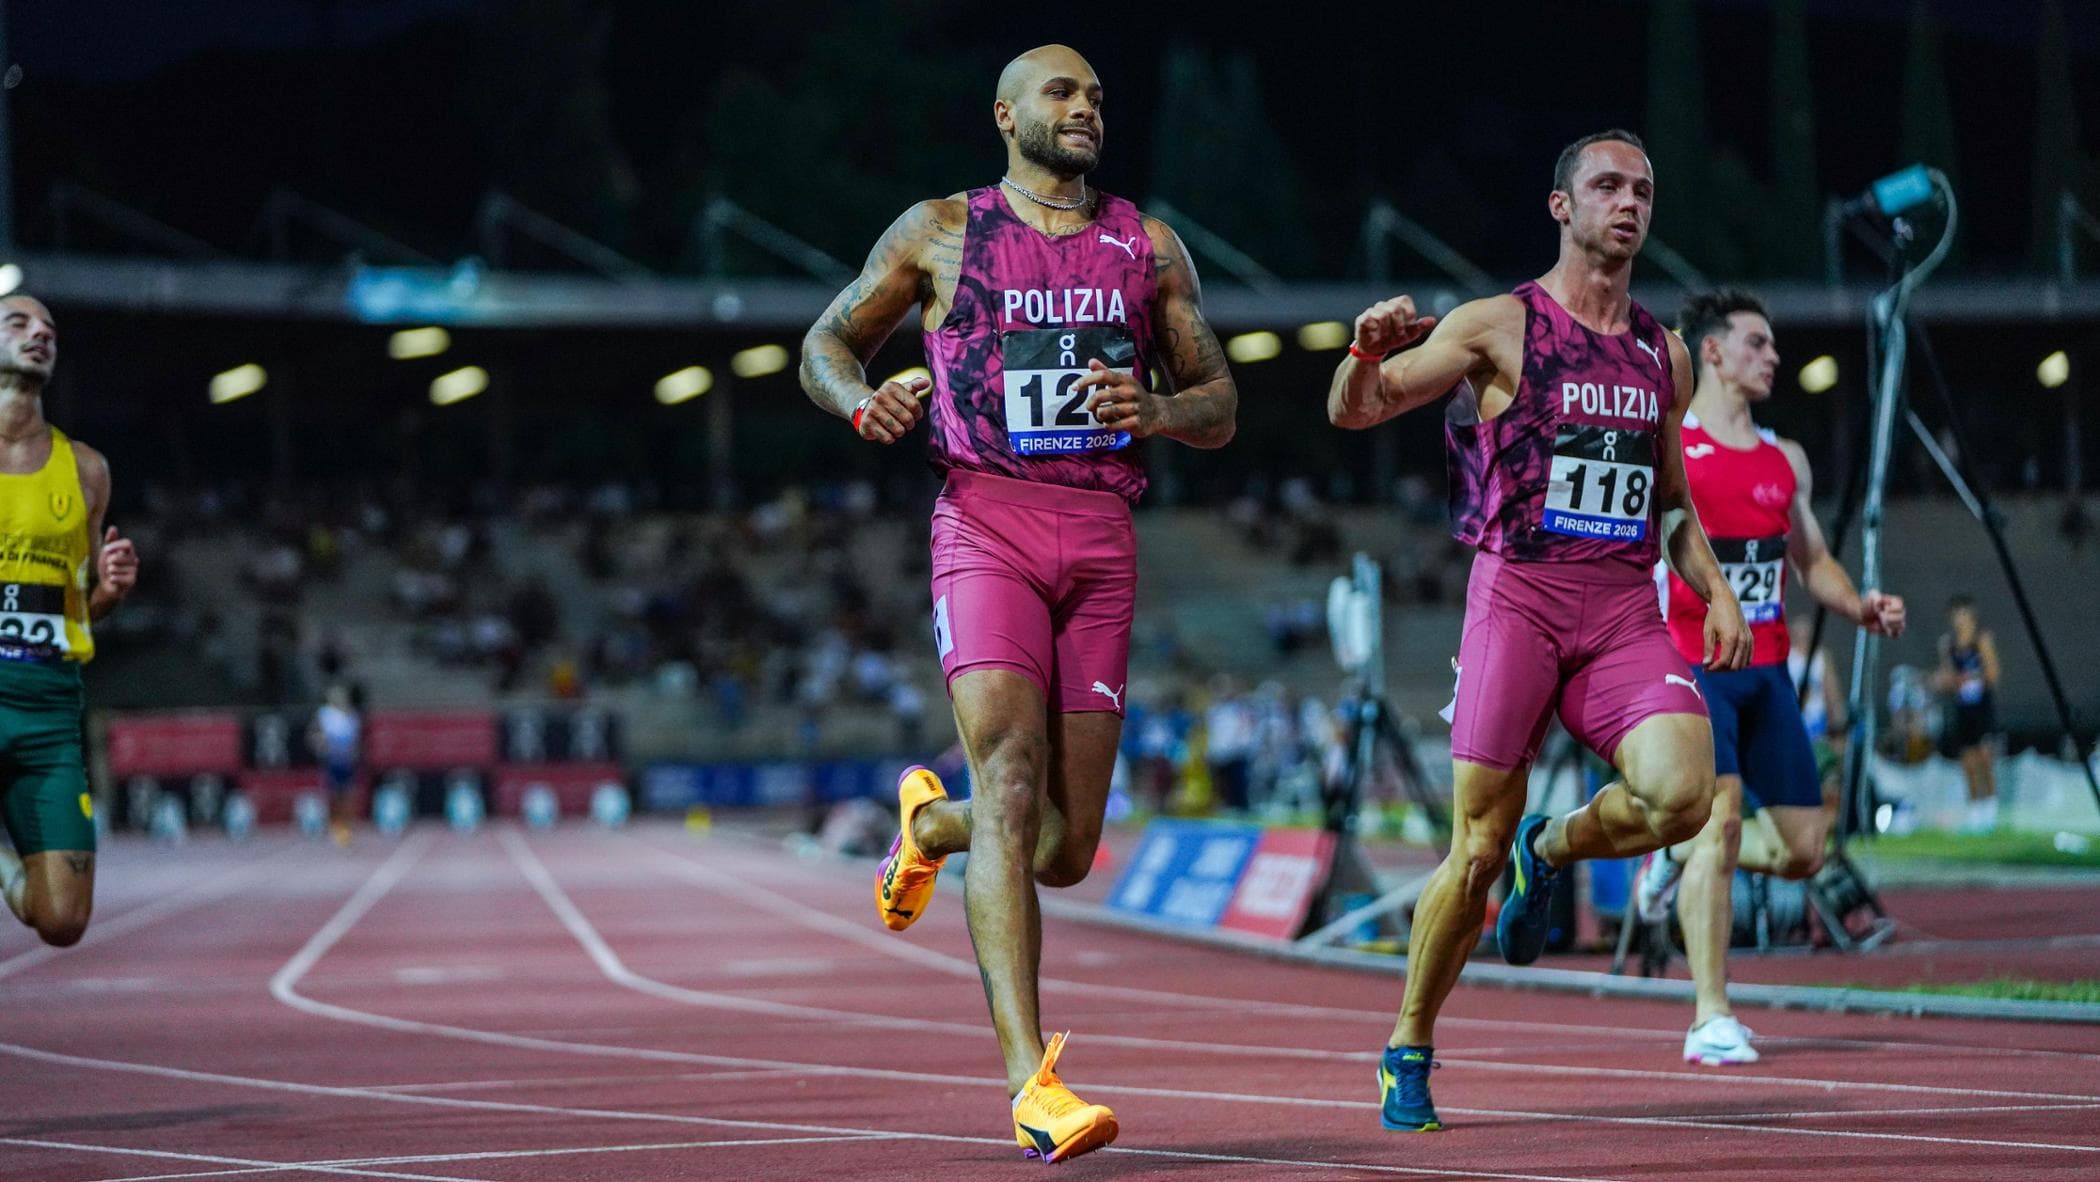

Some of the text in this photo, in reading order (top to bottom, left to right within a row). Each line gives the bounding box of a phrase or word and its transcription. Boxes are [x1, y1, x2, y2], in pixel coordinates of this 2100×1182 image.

[1004, 288, 1126, 324] POLIZIA
[1020, 373, 1107, 427] 12
[1562, 382, 1659, 424] POLIZIA
[1020, 434, 1116, 451] FIRENZE 2026
[1566, 464, 1648, 517] 118
[1555, 516, 1638, 537] FIRENZE 2026
